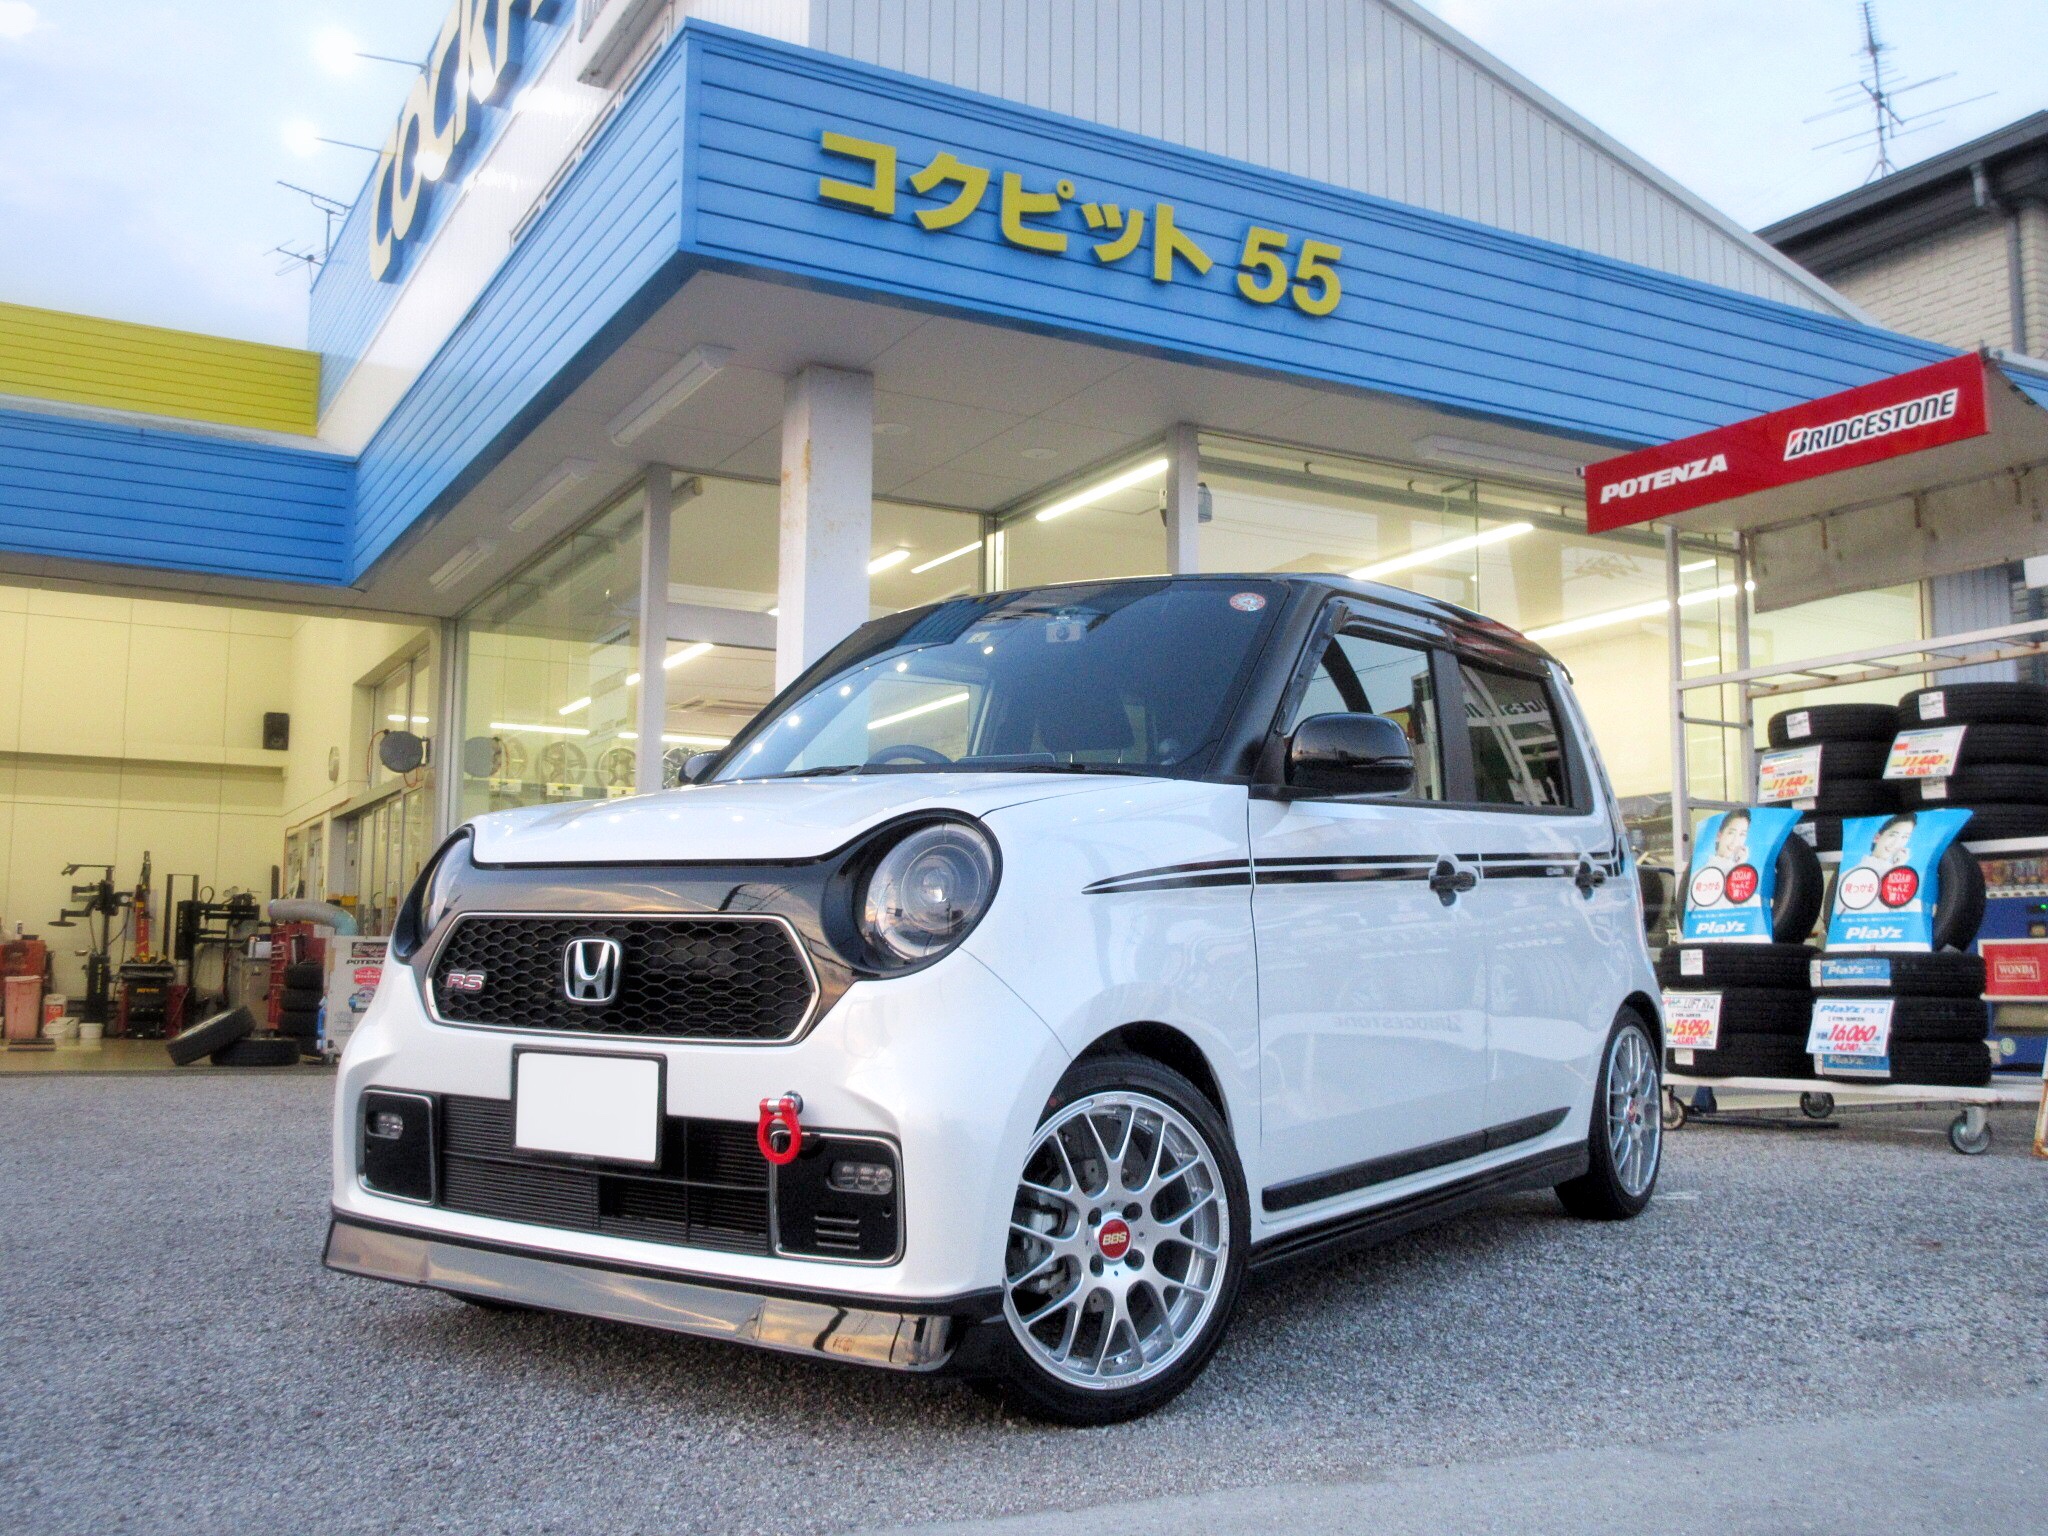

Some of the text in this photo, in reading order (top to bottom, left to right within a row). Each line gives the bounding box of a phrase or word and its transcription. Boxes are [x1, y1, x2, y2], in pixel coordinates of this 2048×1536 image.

[819, 130, 1342, 317] コクピット 55
[1600, 387, 1959, 504] POTENZA BRIDGESTONE
[1999, 964, 2035, 976] WONDA
[446, 973, 484, 991] RS
[1102, 1231, 1128, 1246] BBS
